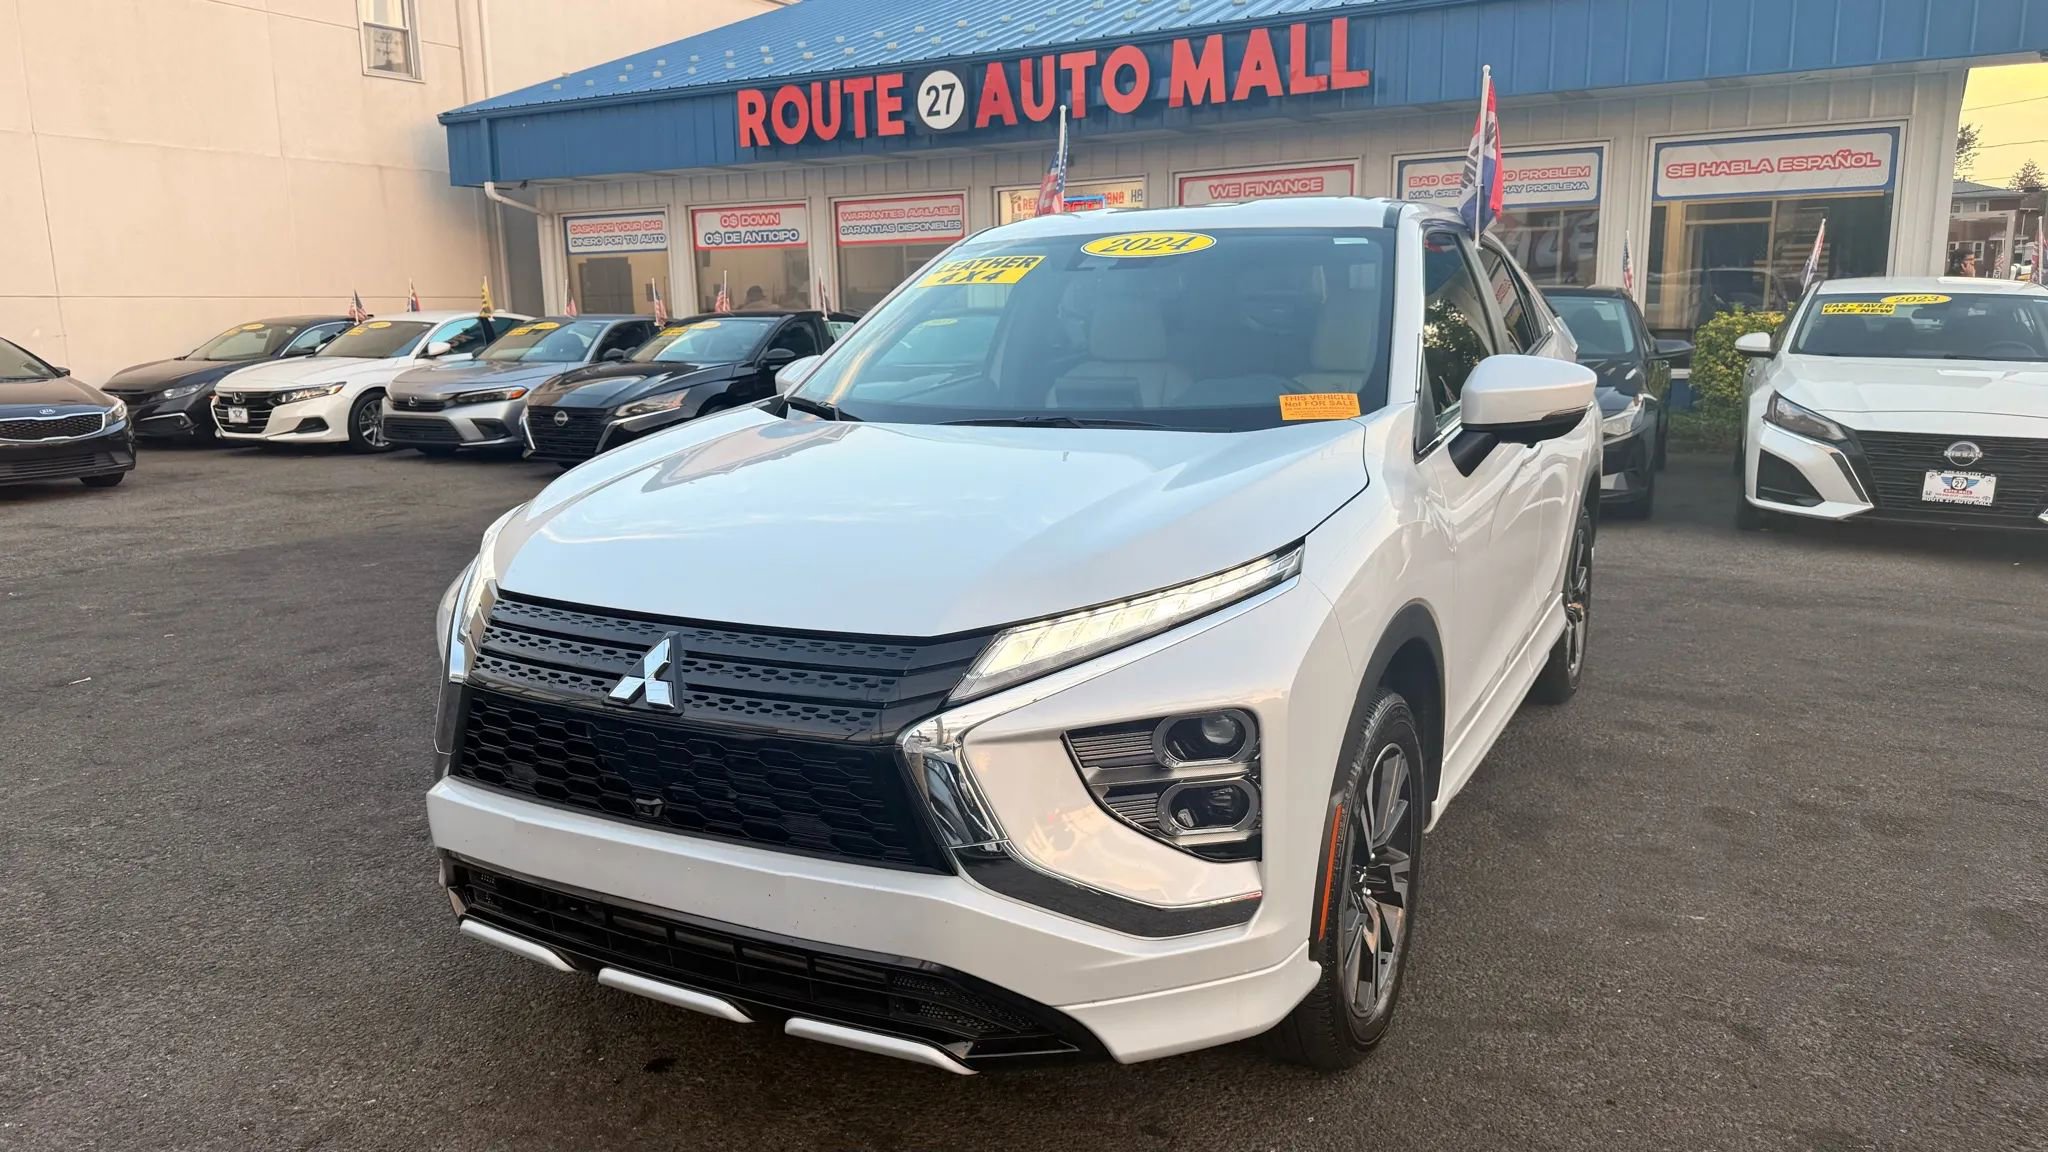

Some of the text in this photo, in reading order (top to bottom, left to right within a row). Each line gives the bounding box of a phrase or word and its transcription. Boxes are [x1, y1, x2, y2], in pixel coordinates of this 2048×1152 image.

[737, 17, 1369, 148] ROUTE 27 AUTO MALL
[1666, 148, 1881, 179] SE HABLA ESPAÑOL
[1408, 175, 1439, 188] BAD
[1518, 165, 1592, 181] PROBLEM
[1208, 176, 1324, 199] WE FINANCE
[1409, 189, 1433, 199] MAL
[1526, 181, 1590, 193] PROBLEMA
[720, 211, 781, 228] 0$ DOWN
[841, 205, 960, 221] WARRANTIES AVAILABLE
[570, 220, 663, 235] CASH FOR YOUR CAR
[840, 220, 962, 236] GARANTIAS DISPONIBLES
[571, 233, 667, 248] DINERO POR TU AUTO
[704, 228, 800, 246] 0$ DE ANTICIPO
[1099, 235, 1198, 253] 2024
[937, 256, 1040, 274] LEATHER
[1894, 295, 1940, 303] 2023
[1954, 480, 1965, 488] 27
